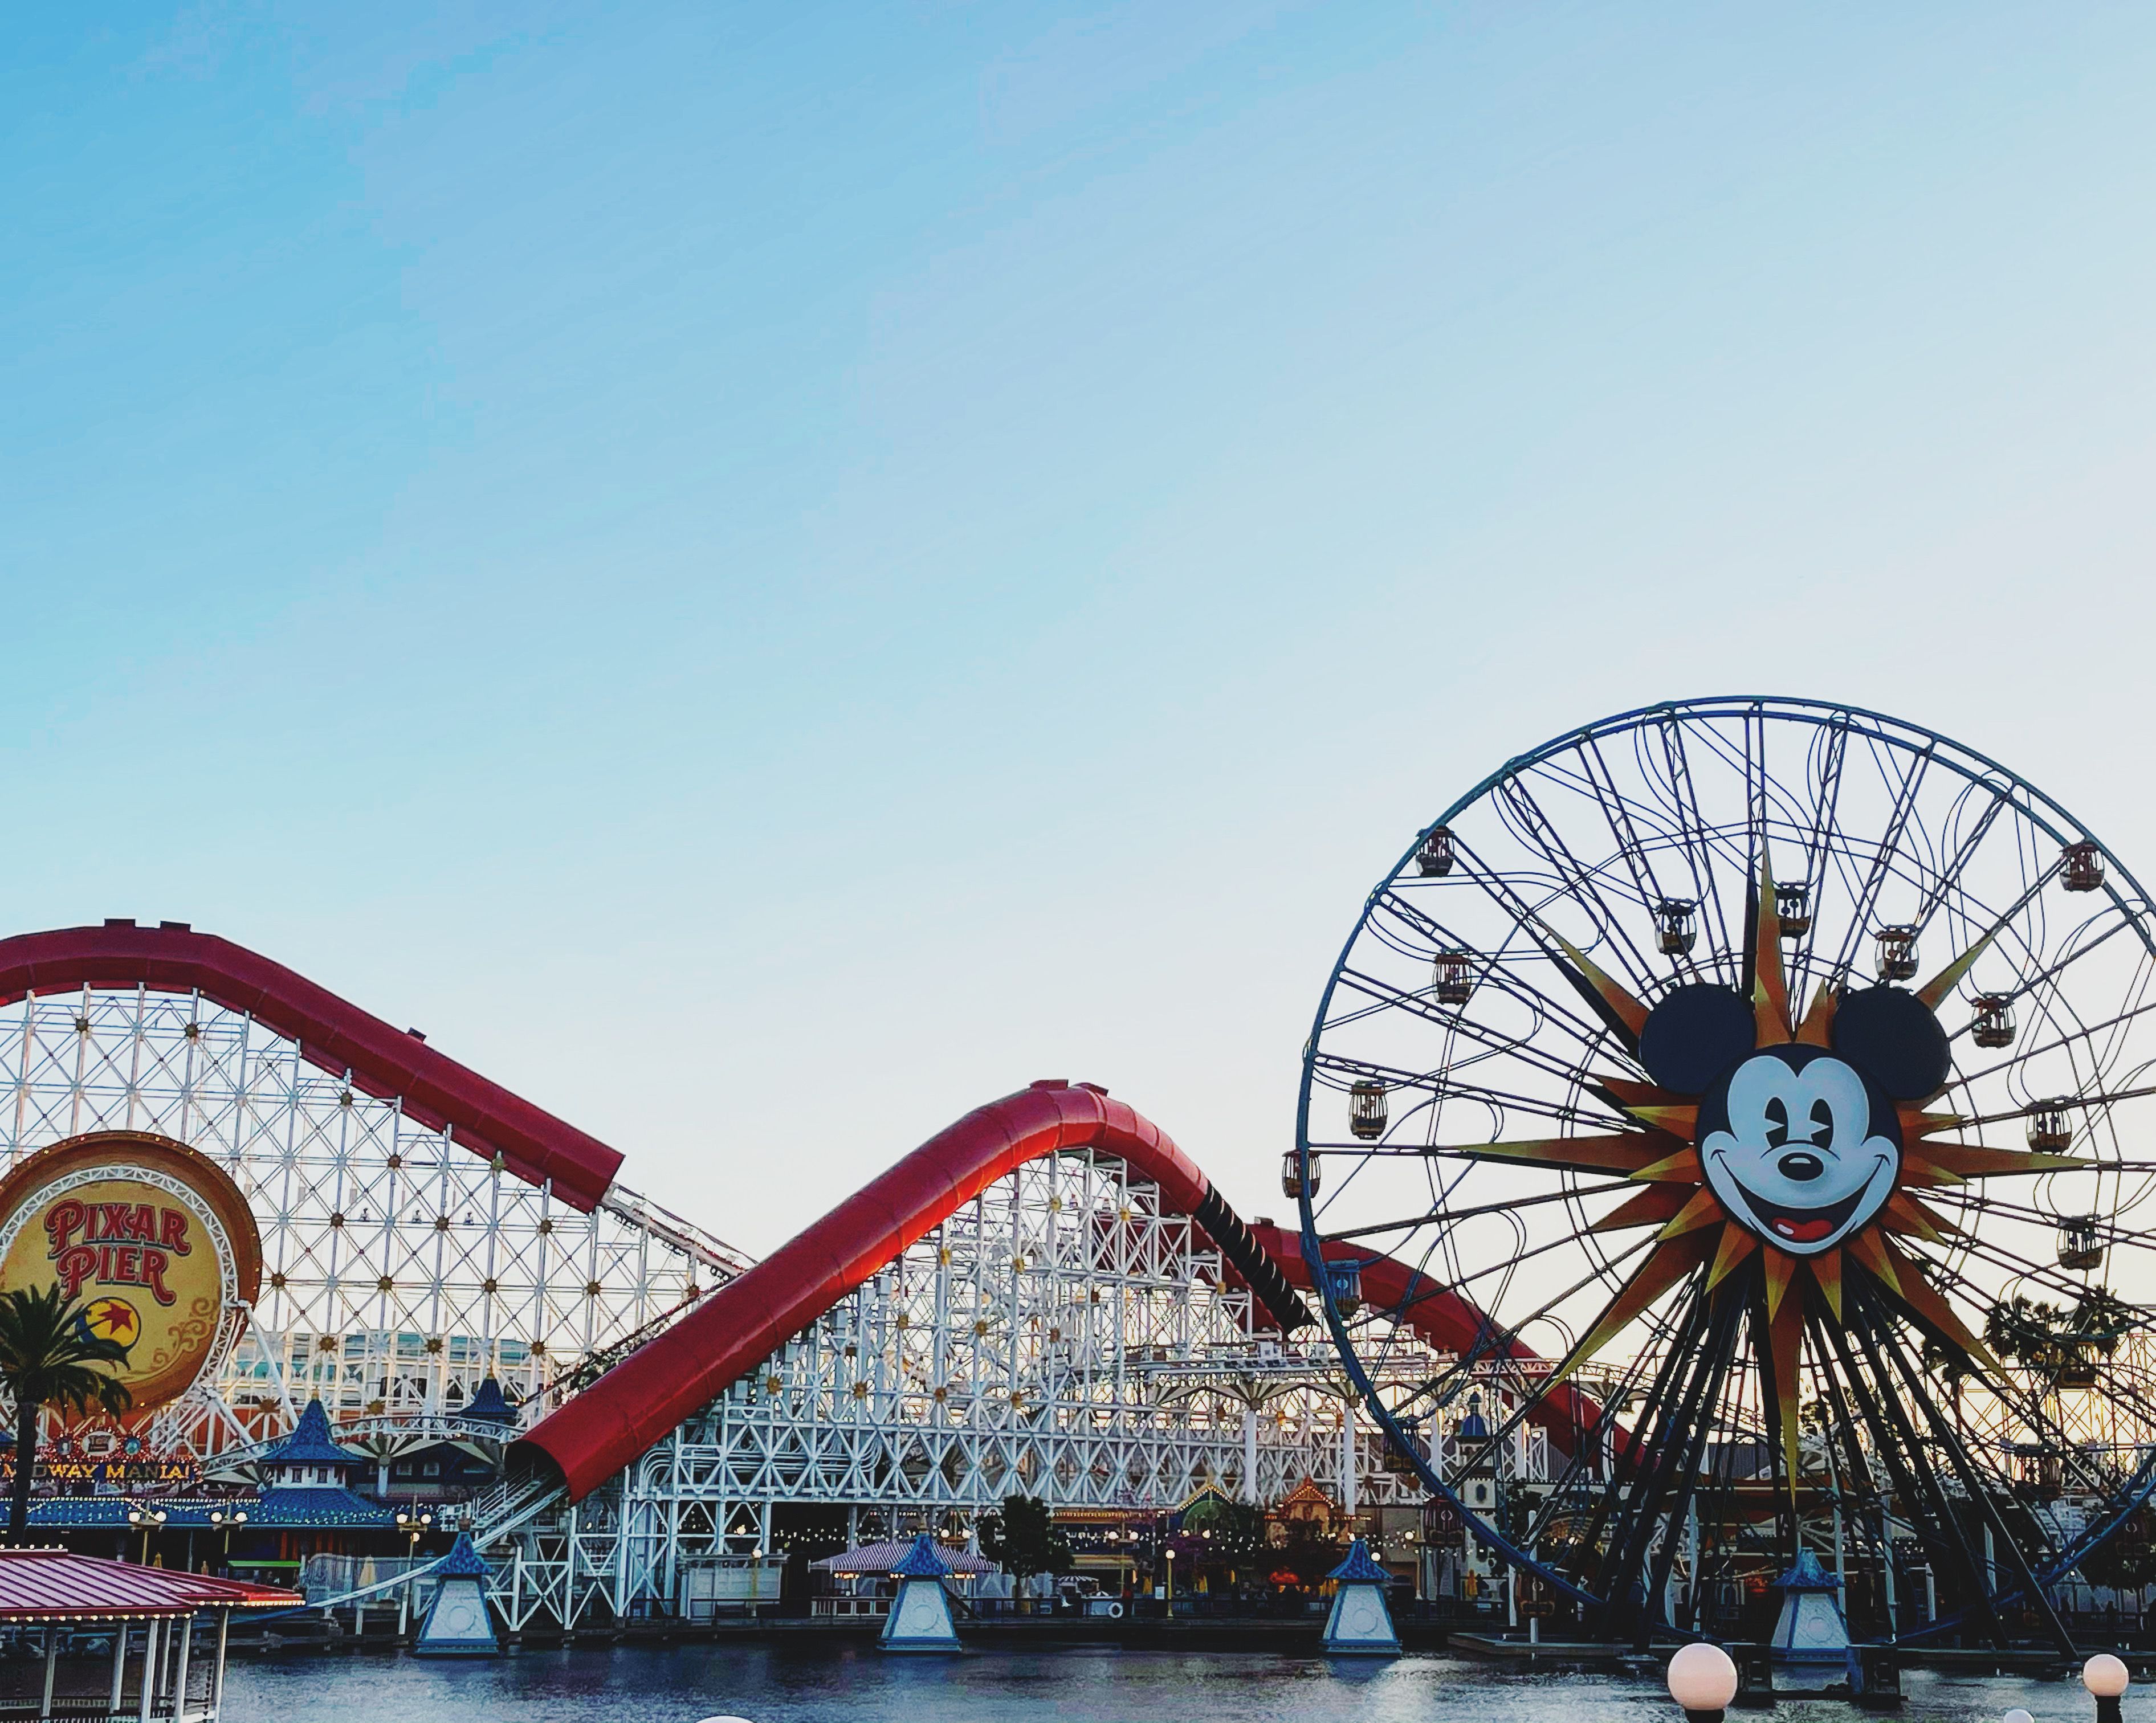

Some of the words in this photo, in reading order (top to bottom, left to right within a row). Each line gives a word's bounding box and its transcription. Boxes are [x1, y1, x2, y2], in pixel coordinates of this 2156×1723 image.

[45, 1199, 191, 1259] PIXAR
[56, 1245, 176, 1306] PIER
[2, 1464, 98, 1478] MDWAY
[105, 1463, 190, 1479] MANIA!
